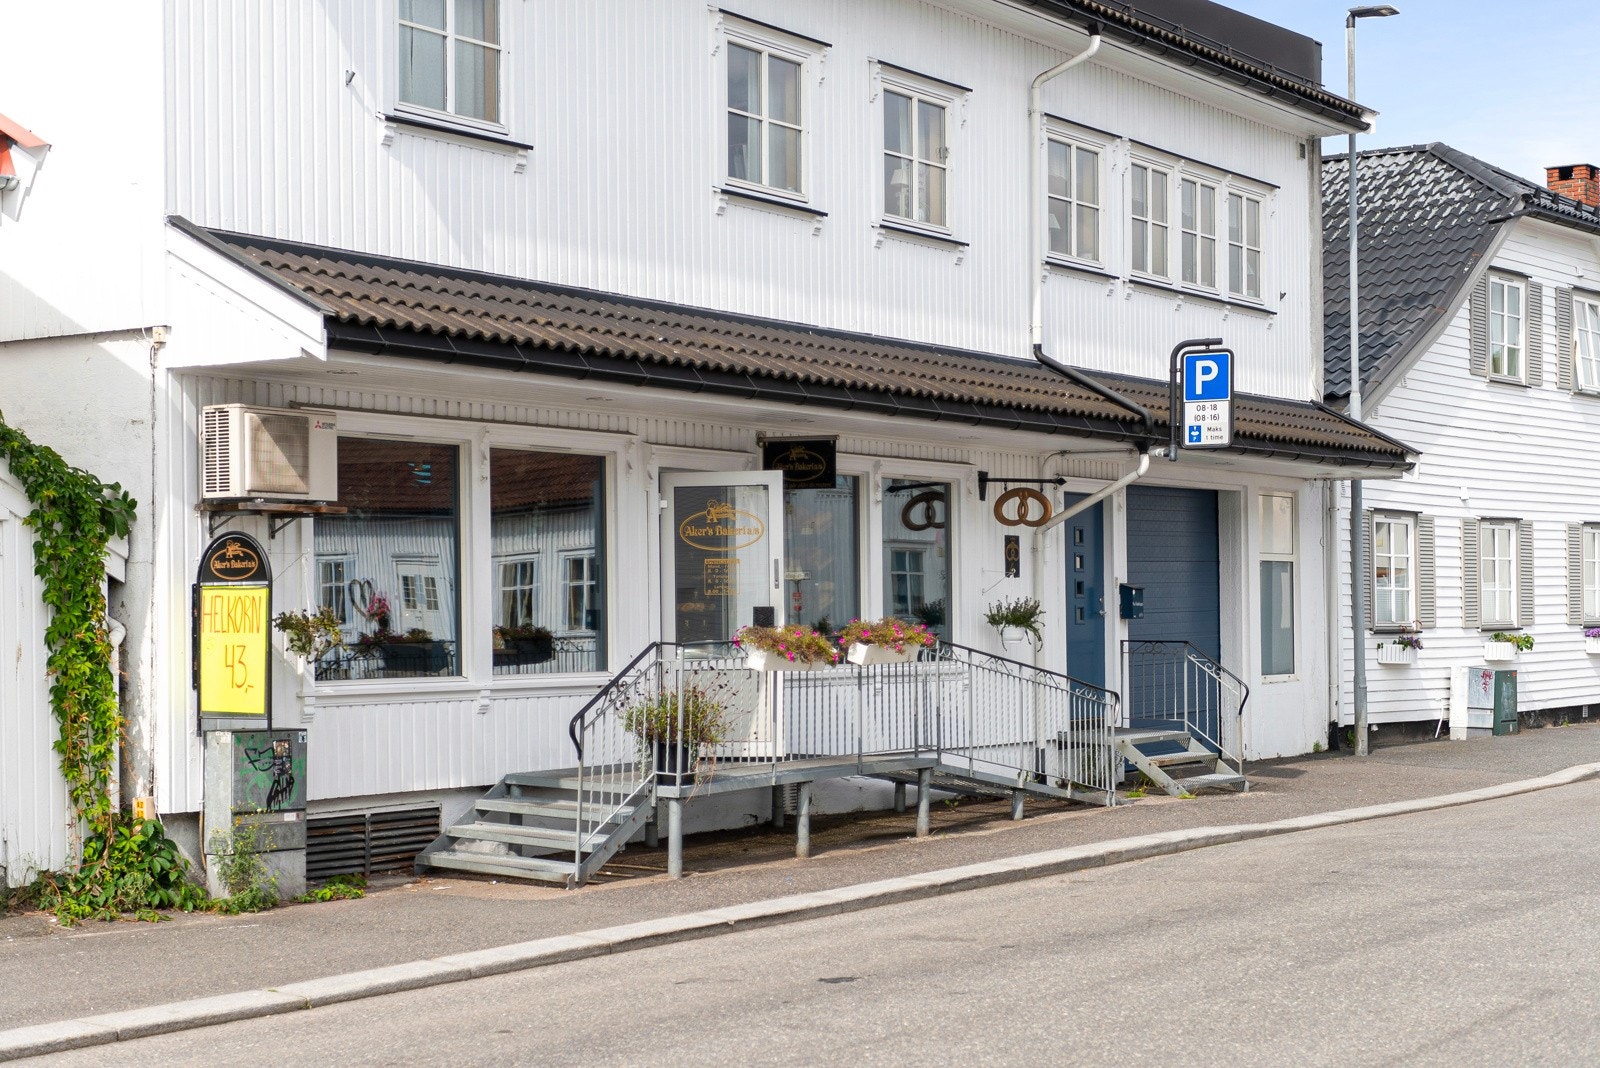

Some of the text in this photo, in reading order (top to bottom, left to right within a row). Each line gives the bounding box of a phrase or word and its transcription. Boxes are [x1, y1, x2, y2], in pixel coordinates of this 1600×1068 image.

[1196, 360, 1218, 395] P
[685, 526, 713, 536] Aker's
[202, 595, 261, 634] HELKORN
